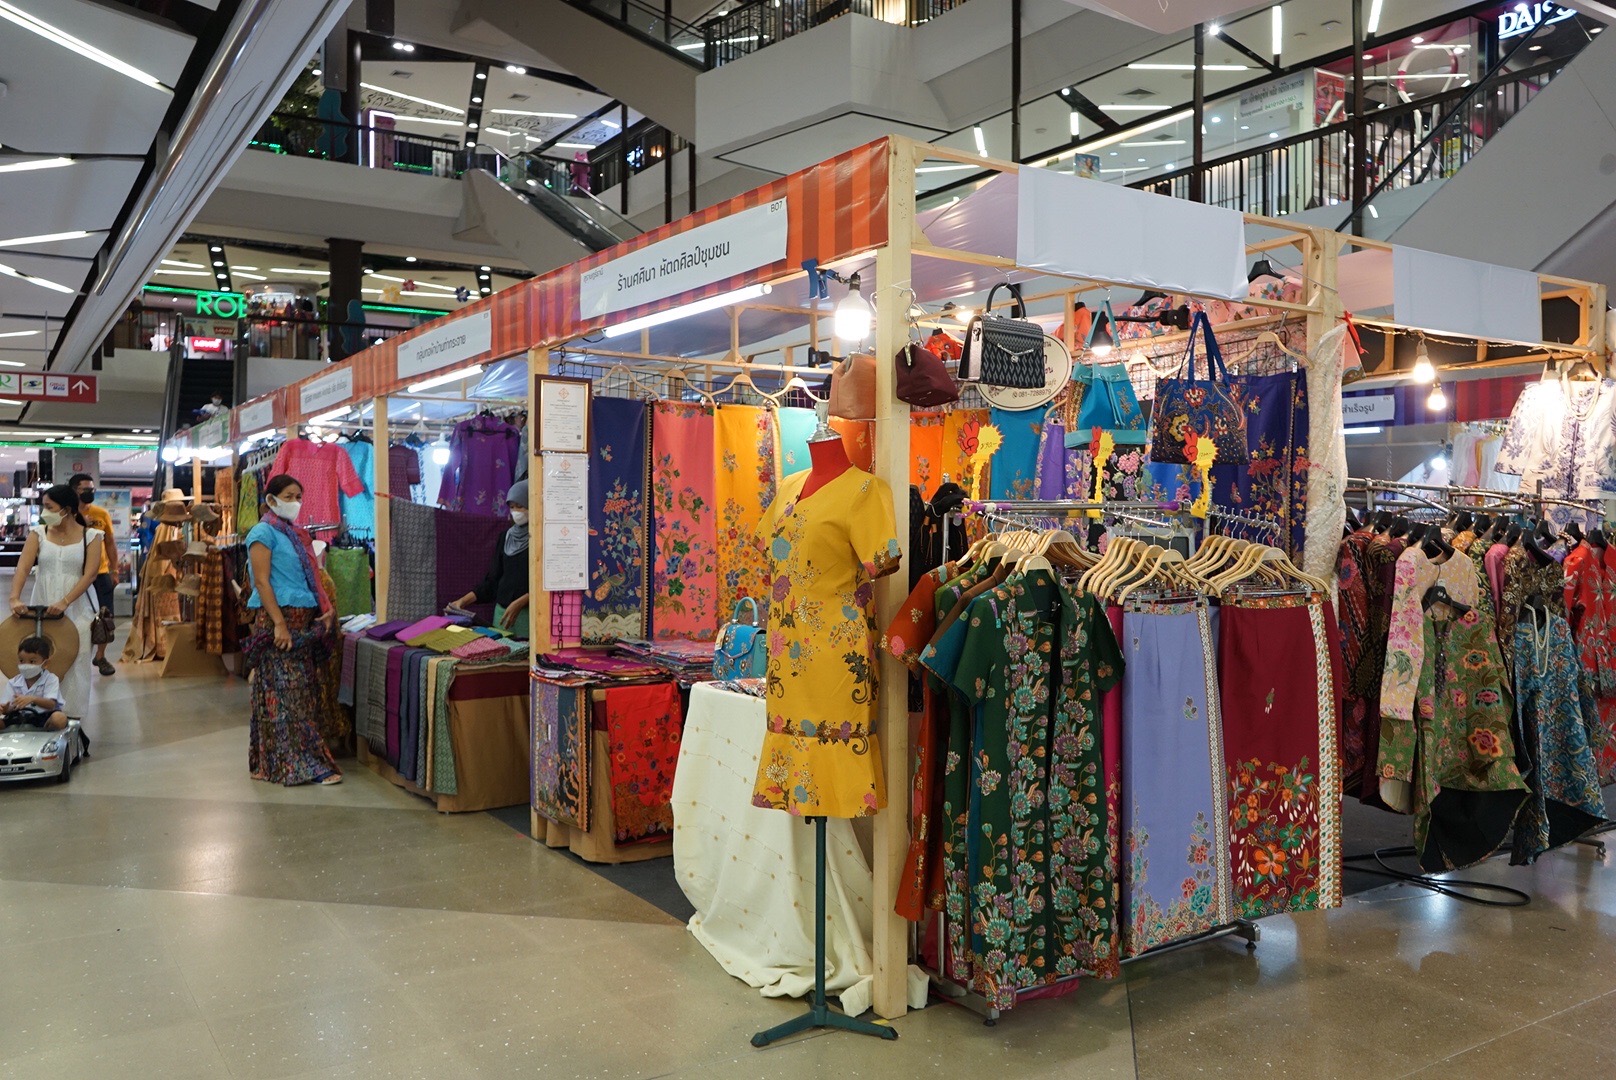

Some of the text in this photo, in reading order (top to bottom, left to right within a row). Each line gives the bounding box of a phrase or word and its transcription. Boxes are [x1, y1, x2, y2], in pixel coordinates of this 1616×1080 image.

[770, 200, 783, 213] B07
[617, 241, 730, 292] ร้านศศินา หัตถศิลป์ชุมชน
